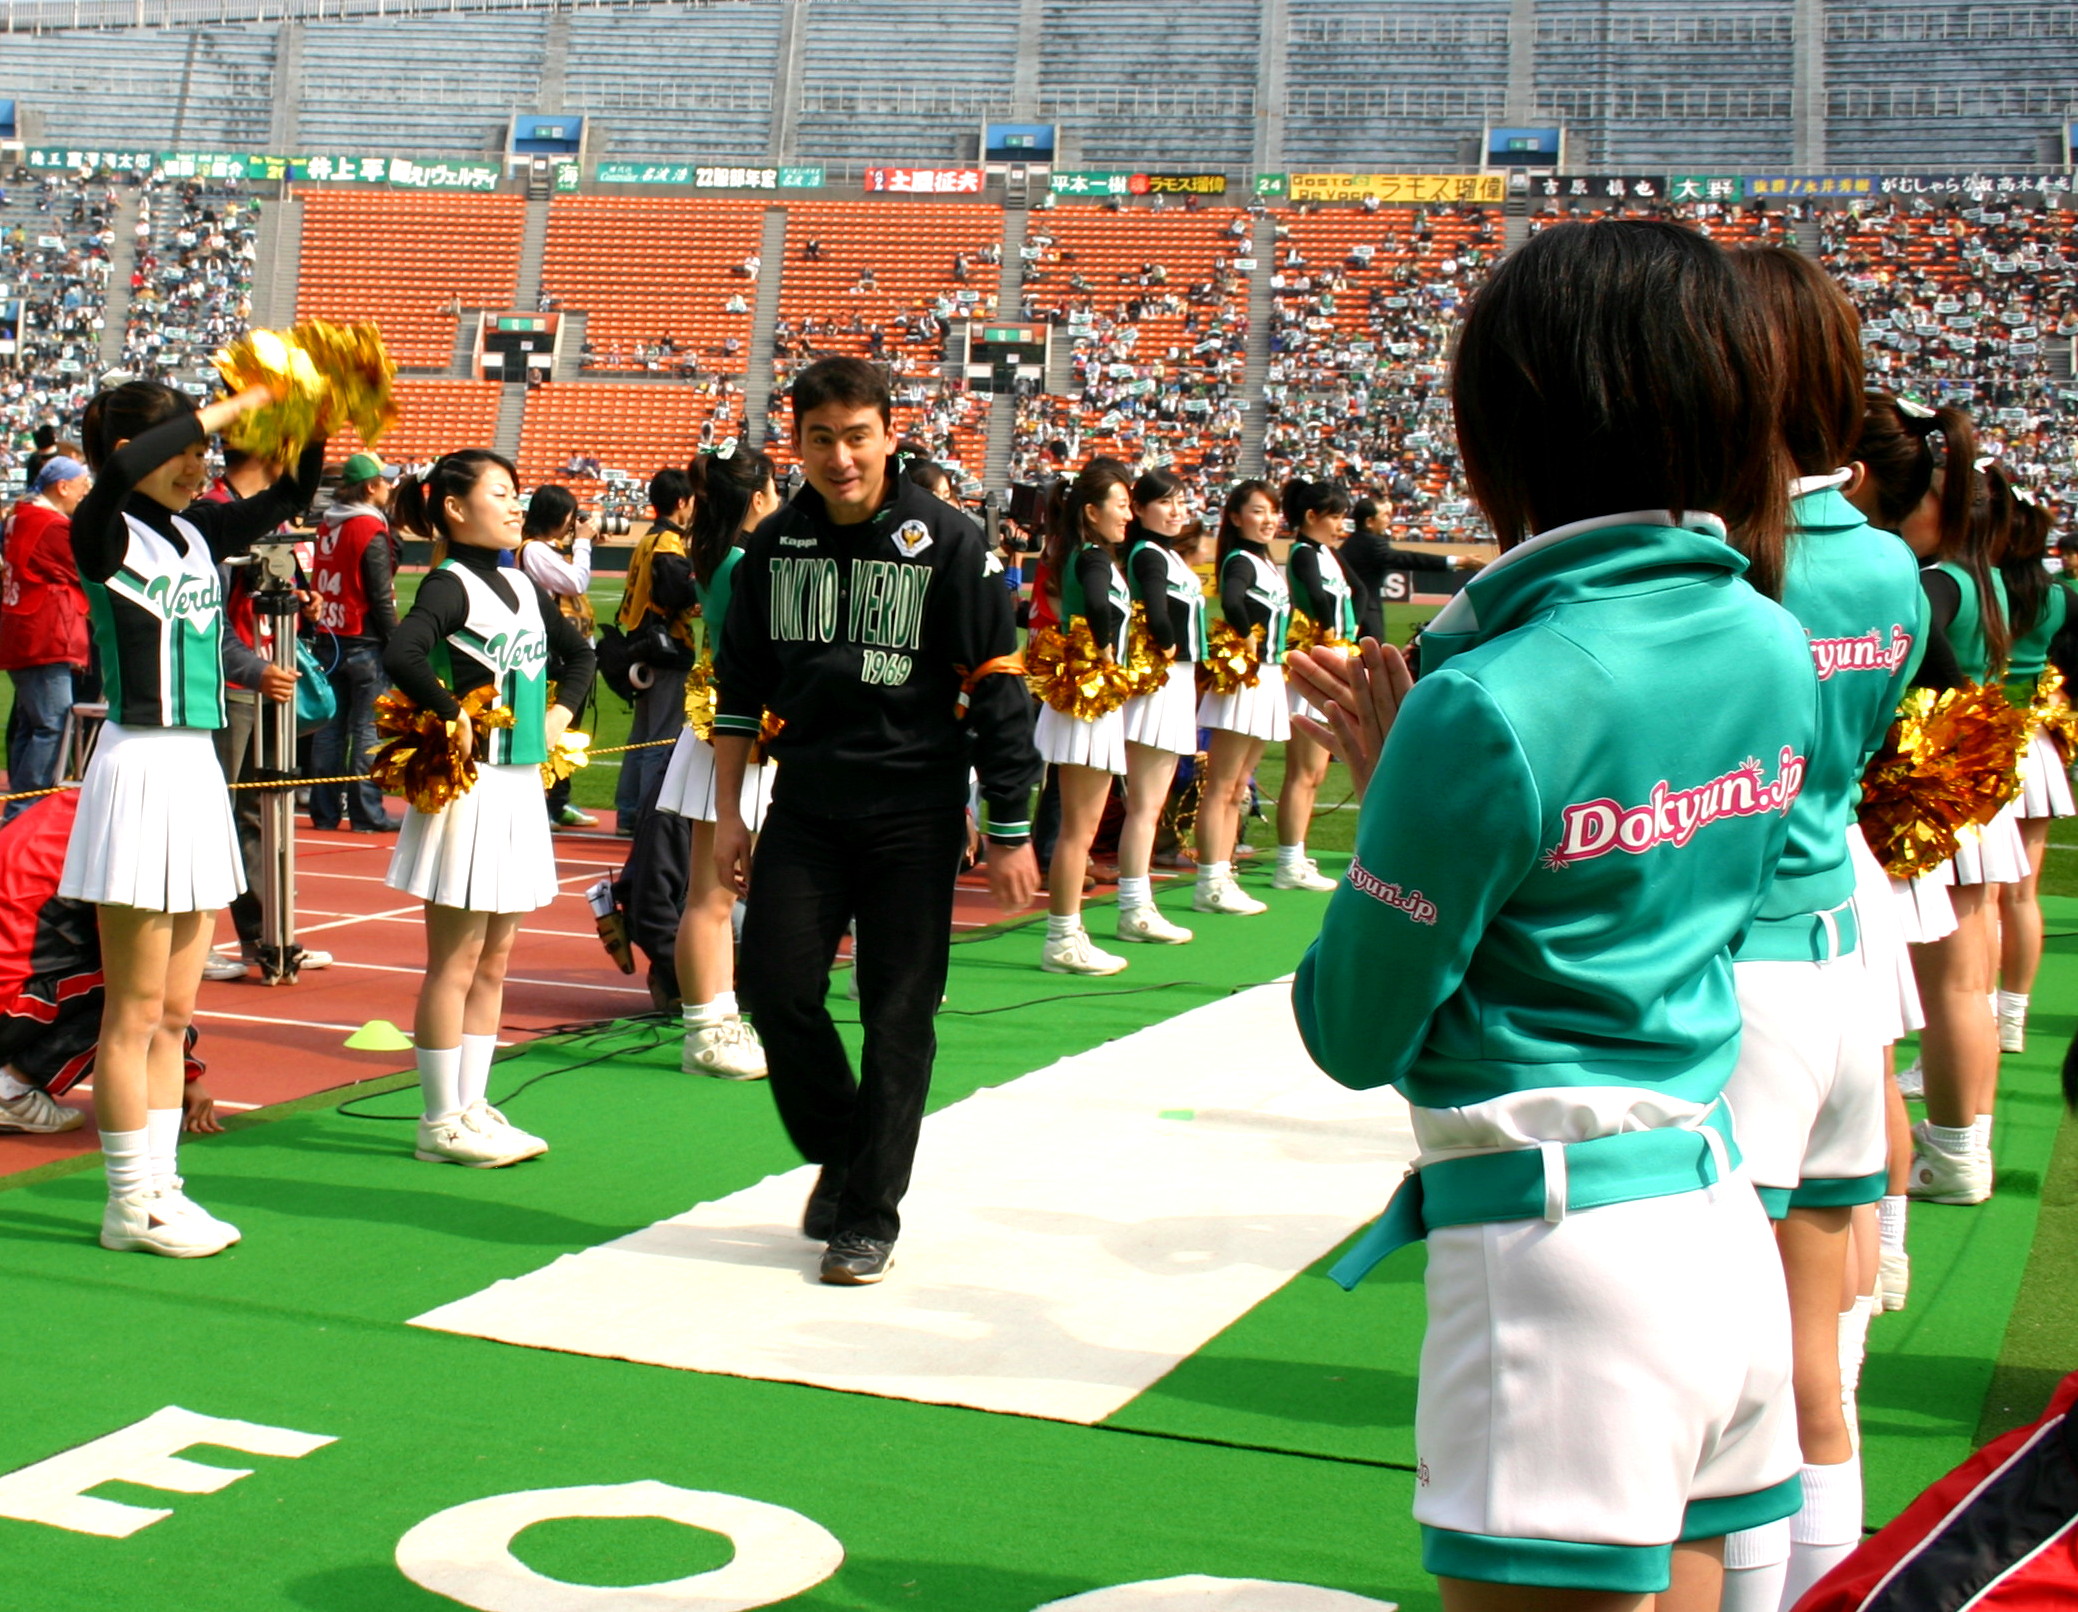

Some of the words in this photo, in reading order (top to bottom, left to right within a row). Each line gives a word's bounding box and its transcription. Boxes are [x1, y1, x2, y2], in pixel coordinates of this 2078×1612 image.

[888, 170, 978, 192] 土屋征夫
[1052, 174, 1128, 193] 平本一樹
[1259, 179, 1281, 191] 24
[1381, 177, 1501, 200] ラモス瑠偉
[1675, 178, 1734, 200] 大野
[779, 536, 818, 548] Kappa
[318, 568, 342, 596] 04
[769, 557, 839, 643] TOKYO
[848, 558, 933, 651] VERDY
[1810, 627, 1909, 677] yun.jp
[861, 650, 912, 686] 1969
[1562, 749, 1806, 855] Dokyun.jp
